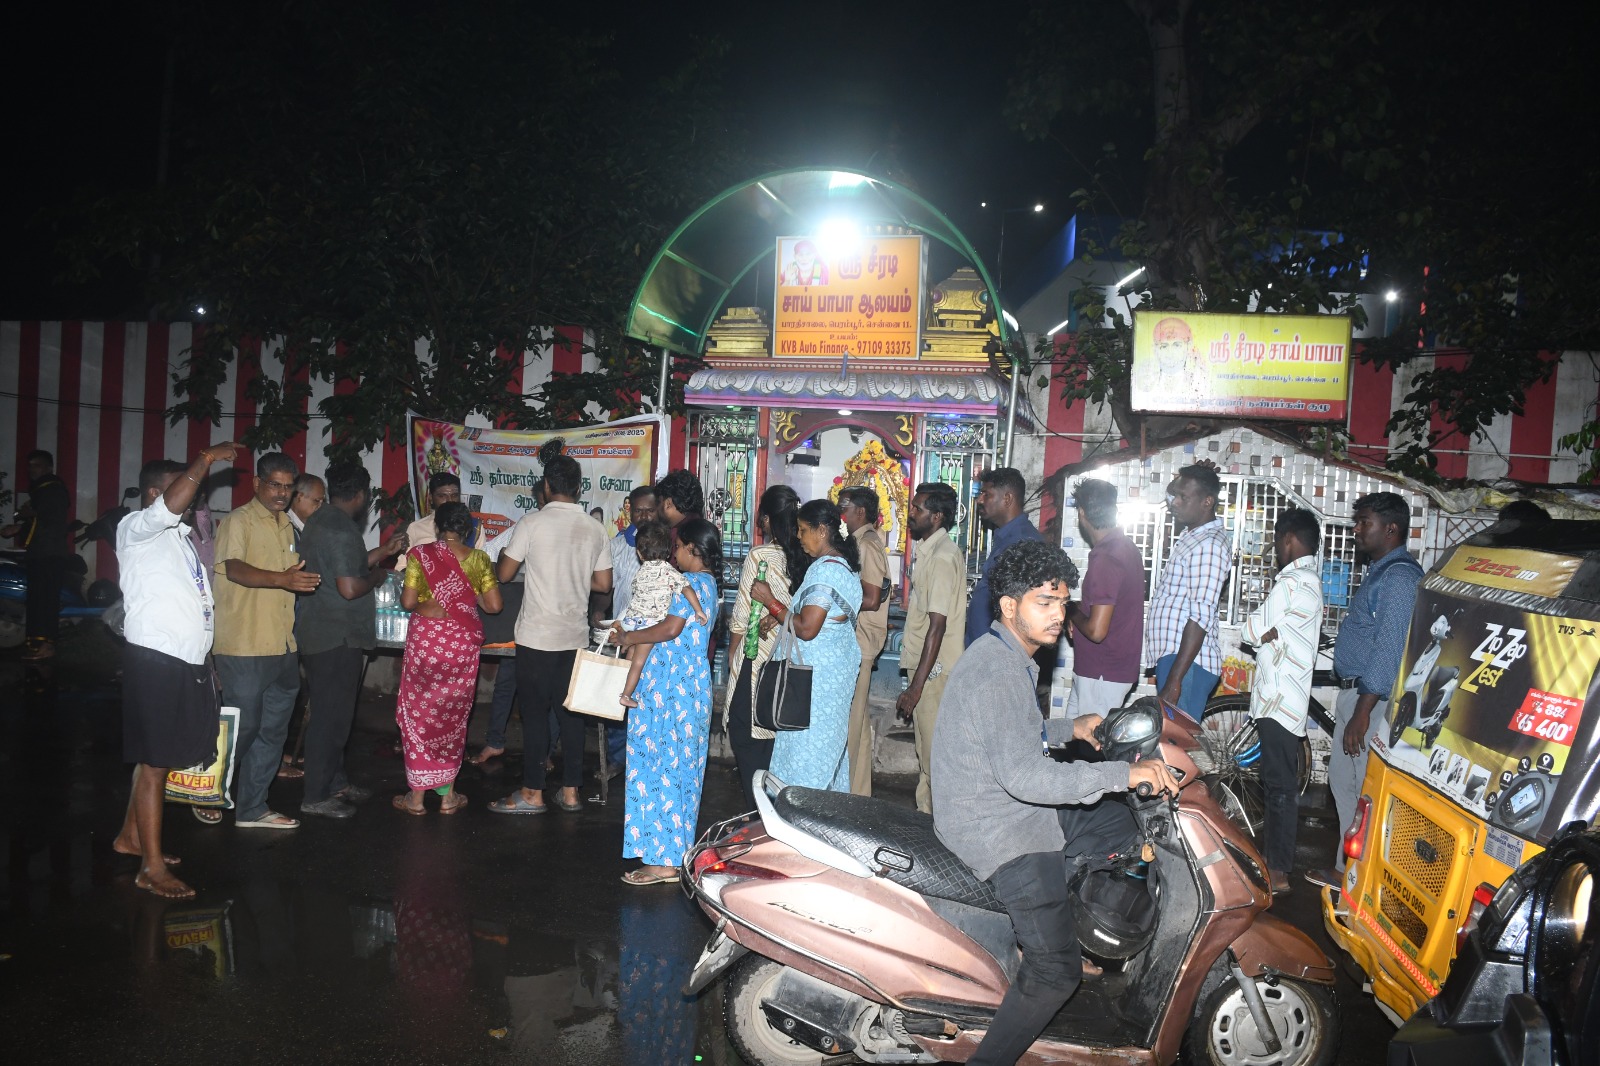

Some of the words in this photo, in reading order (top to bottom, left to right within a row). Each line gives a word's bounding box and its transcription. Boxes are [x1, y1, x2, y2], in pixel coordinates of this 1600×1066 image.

[867, 244, 899, 280] சீரடி
[782, 286, 813, 313] சாய்
[817, 294, 854, 313] பாபா
[858, 287, 912, 319] ஆலயம்
[867, 319, 900, 329] சென்னை
[781, 340, 797, 354] KVB
[799, 340, 817, 354] Auto
[820, 341, 849, 355] Finance
[857, 341, 883, 354] 97109
[885, 341, 911, 355] 33375
[1209, 333, 1231, 363] ஸ்ரீ
[1234, 333, 1266, 365] சீரடி
[1269, 335, 1301, 361] சாய்
[1304, 344, 1345, 362] பாபா
[1246, 398, 1305, 410] நண்பர்கள்
[1307, 402, 1331, 412] குழு
[470, 465, 484, 485] ஸ்ரீ
[489, 467, 544, 488] தர்மசாஸ்
[600, 475, 634, 492] சேவா
[1558, 624, 1576, 636] TVS
[1470, 622, 1504, 662] Zip
[1490, 627, 1528, 670] Zap
[1460, 652, 1504, 695] Zest
[167, 771, 215, 788] KAVERI
[1383, 868, 1393, 885] TN
[1392, 879, 1402, 893] 05
[1402, 885, 1412, 902] CU
